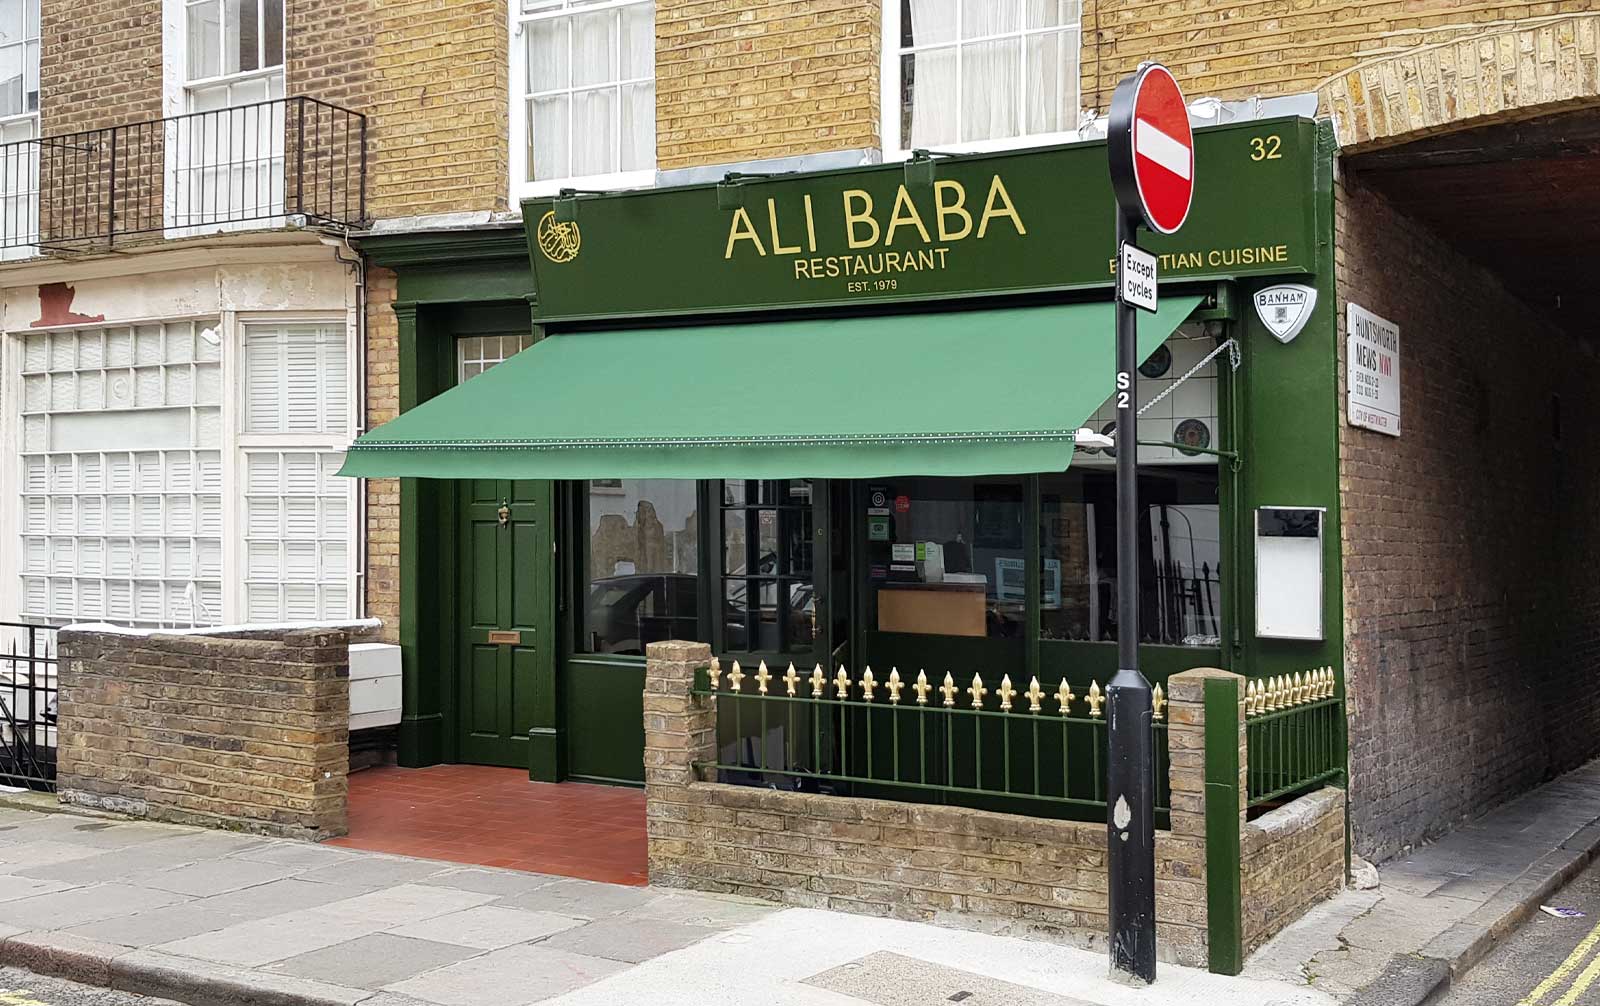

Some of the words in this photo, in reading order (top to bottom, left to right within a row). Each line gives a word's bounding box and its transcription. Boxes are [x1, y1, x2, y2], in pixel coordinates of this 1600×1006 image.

[1250, 135, 1282, 161] 32
[725, 194, 817, 259] ALI
[843, 174, 1027, 249] BABA
[794, 248, 949, 280] RESTAURANT
[1109, 253, 1203, 274] ETIAN
[1208, 245, 1288, 266] CUISINE
[1127, 253, 1154, 280] Except
[847, 281, 871, 293] EST.
[873, 279, 898, 291] 1979
[1128, 280, 1153, 300] cycles
[1260, 292, 1304, 306] BANHAM
[1355, 314, 1397, 353] HUNTSWORTH
[1356, 342, 1377, 372] MEWS
[1379, 352, 1392, 377] NW1
